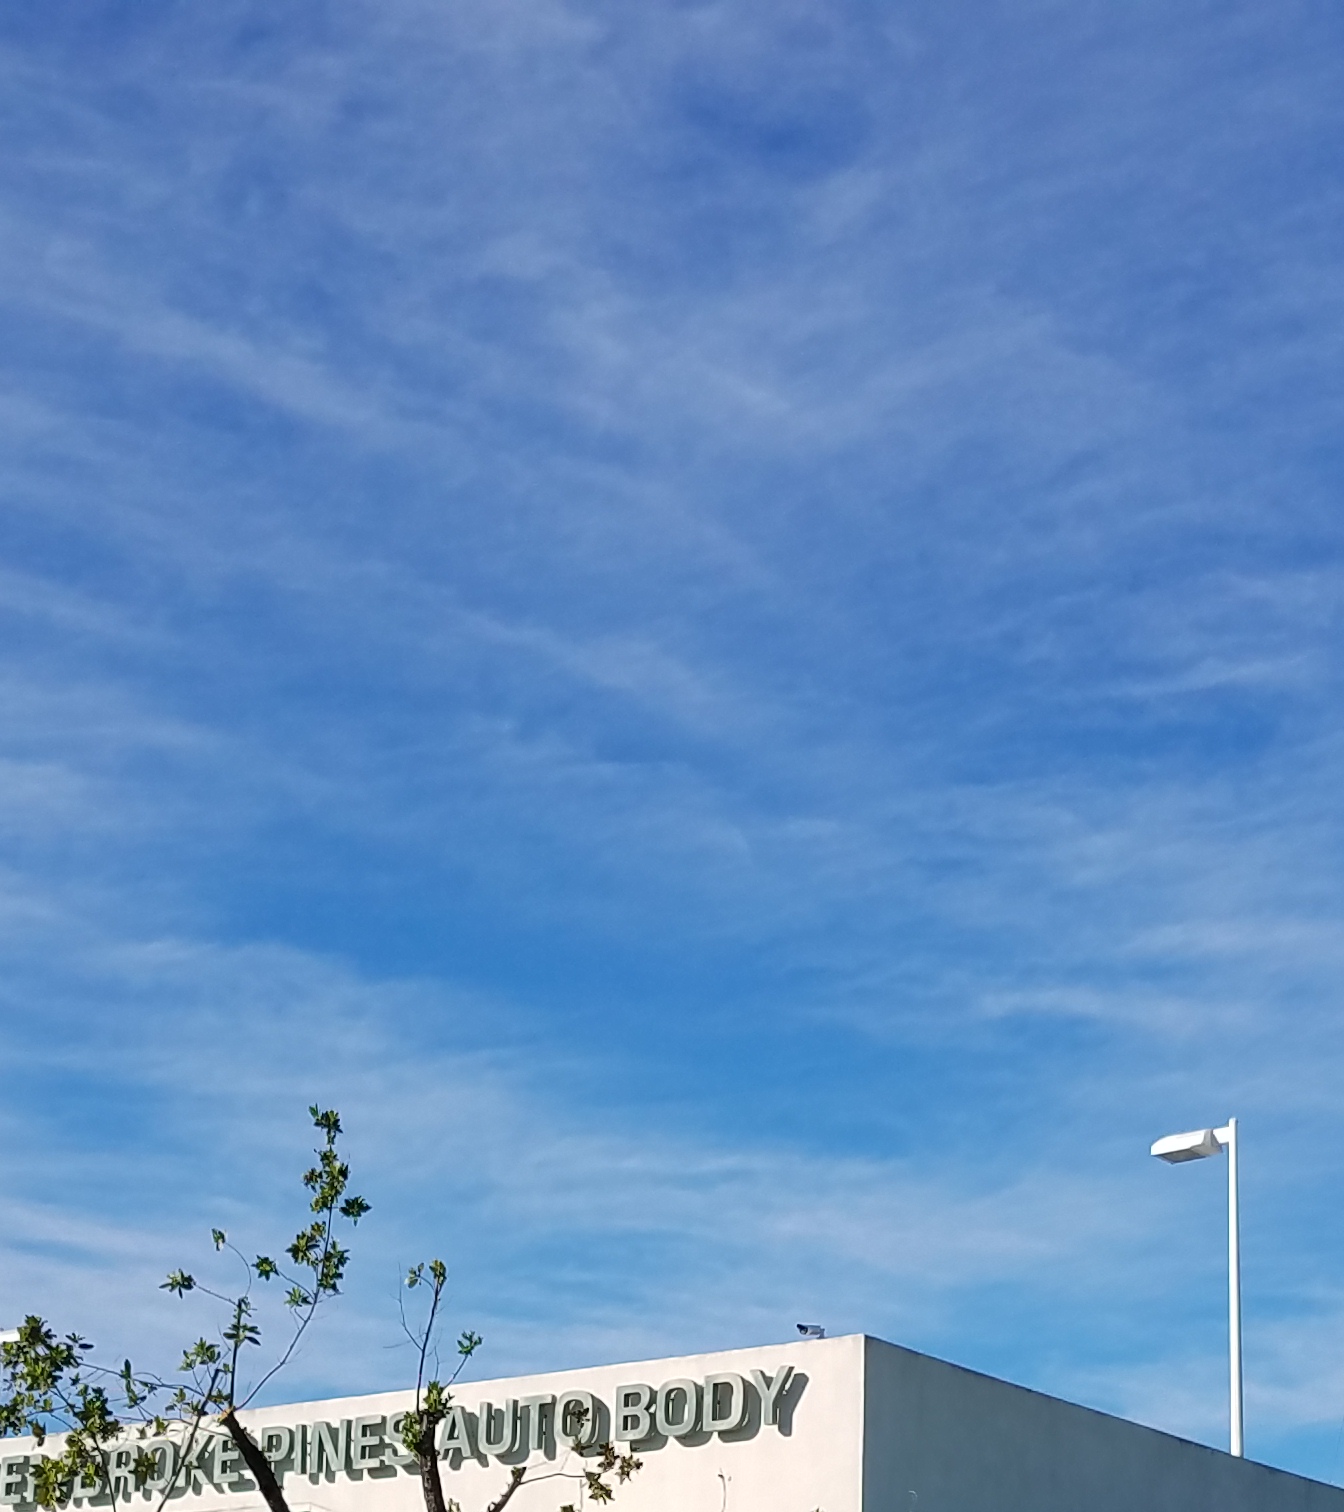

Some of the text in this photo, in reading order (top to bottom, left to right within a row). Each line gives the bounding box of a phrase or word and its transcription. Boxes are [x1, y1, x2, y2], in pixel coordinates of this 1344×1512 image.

[259, 1410, 420, 1477] PINES
[440, 1389, 594, 1460] AUTO
[613, 1365, 796, 1442] BODY
